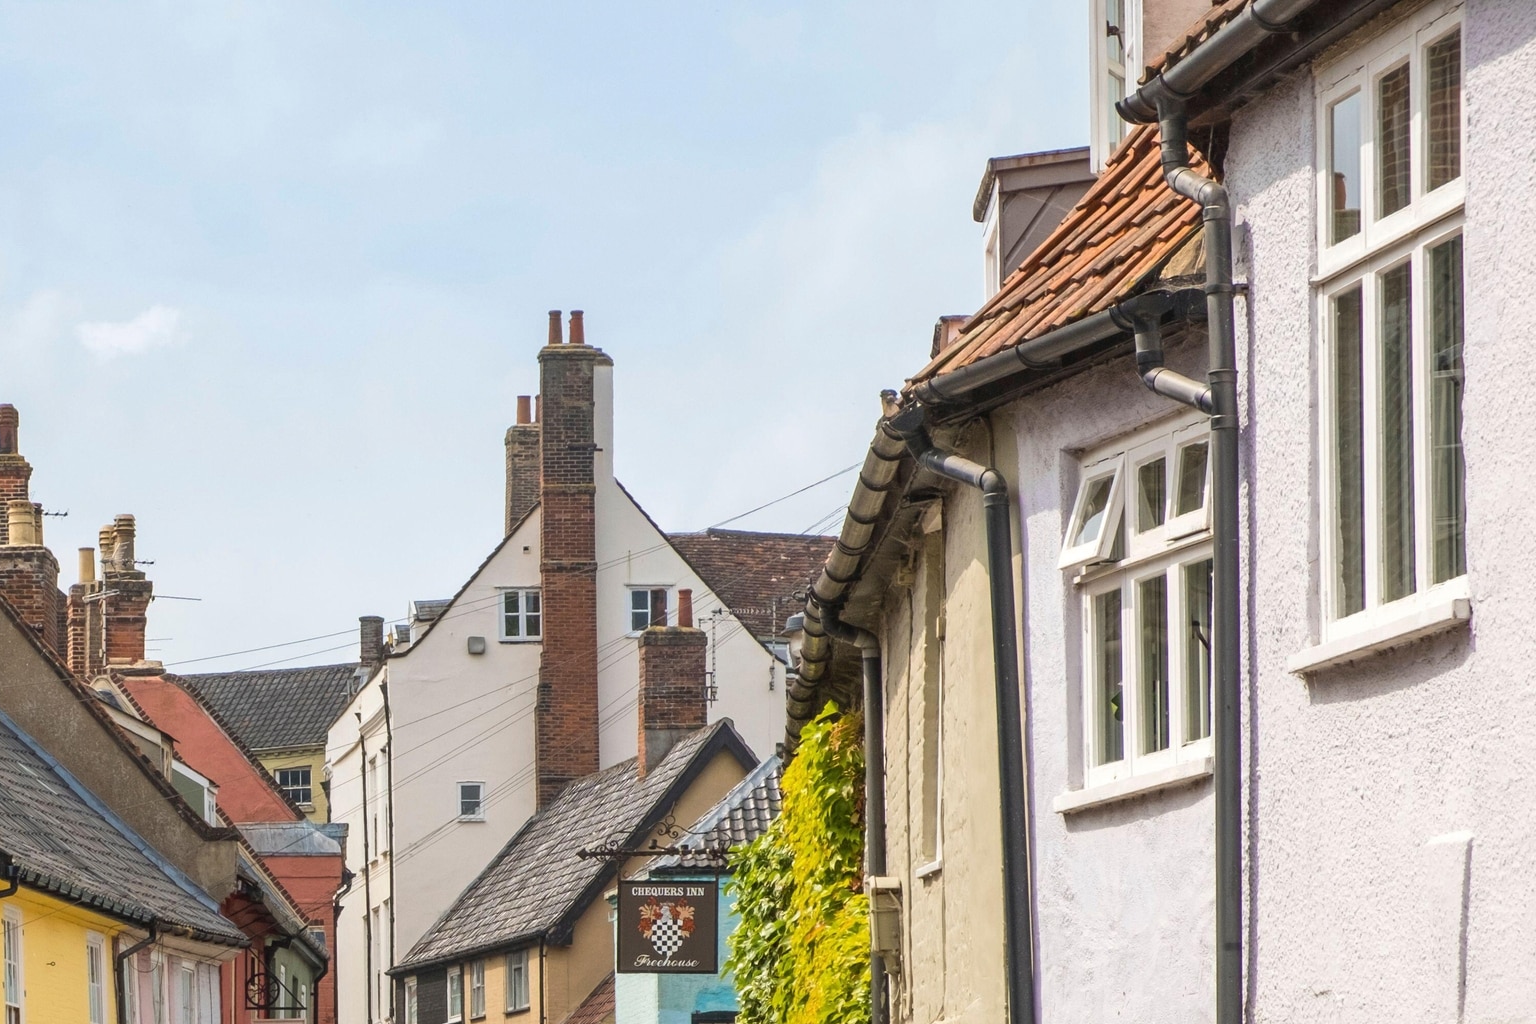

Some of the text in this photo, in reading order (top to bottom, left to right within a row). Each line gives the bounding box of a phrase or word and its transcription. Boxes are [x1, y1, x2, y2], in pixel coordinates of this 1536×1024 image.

[632, 887, 705, 896] CHEQUERS INN
[634, 954, 700, 967] Freehouse
